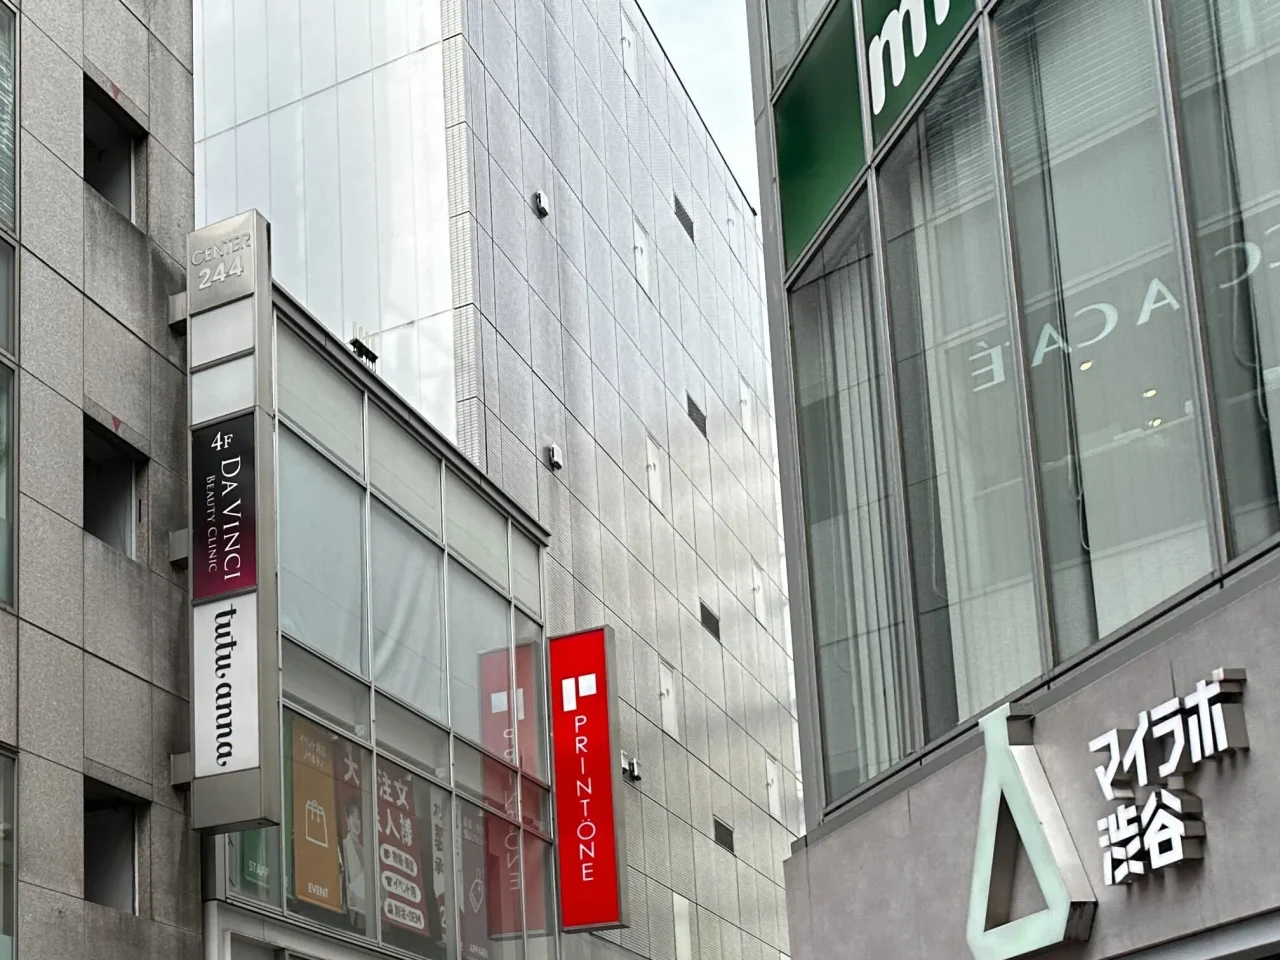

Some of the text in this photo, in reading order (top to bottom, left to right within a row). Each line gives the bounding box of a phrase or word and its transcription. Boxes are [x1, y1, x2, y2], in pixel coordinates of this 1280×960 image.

[191, 233, 251, 266] CENTER
[198, 257, 245, 291] 244
[211, 432, 233, 450] 4F
[206, 474, 218, 573] BEAUTY CLINIC
[214, 603, 237, 767] tutu anna
[1088, 668, 1228, 800] マイラボ
[574, 715, 596, 881] PRINTÖNE
[1097, 788, 1186, 886] 渋谷
[308, 883, 329, 898] EVENT
